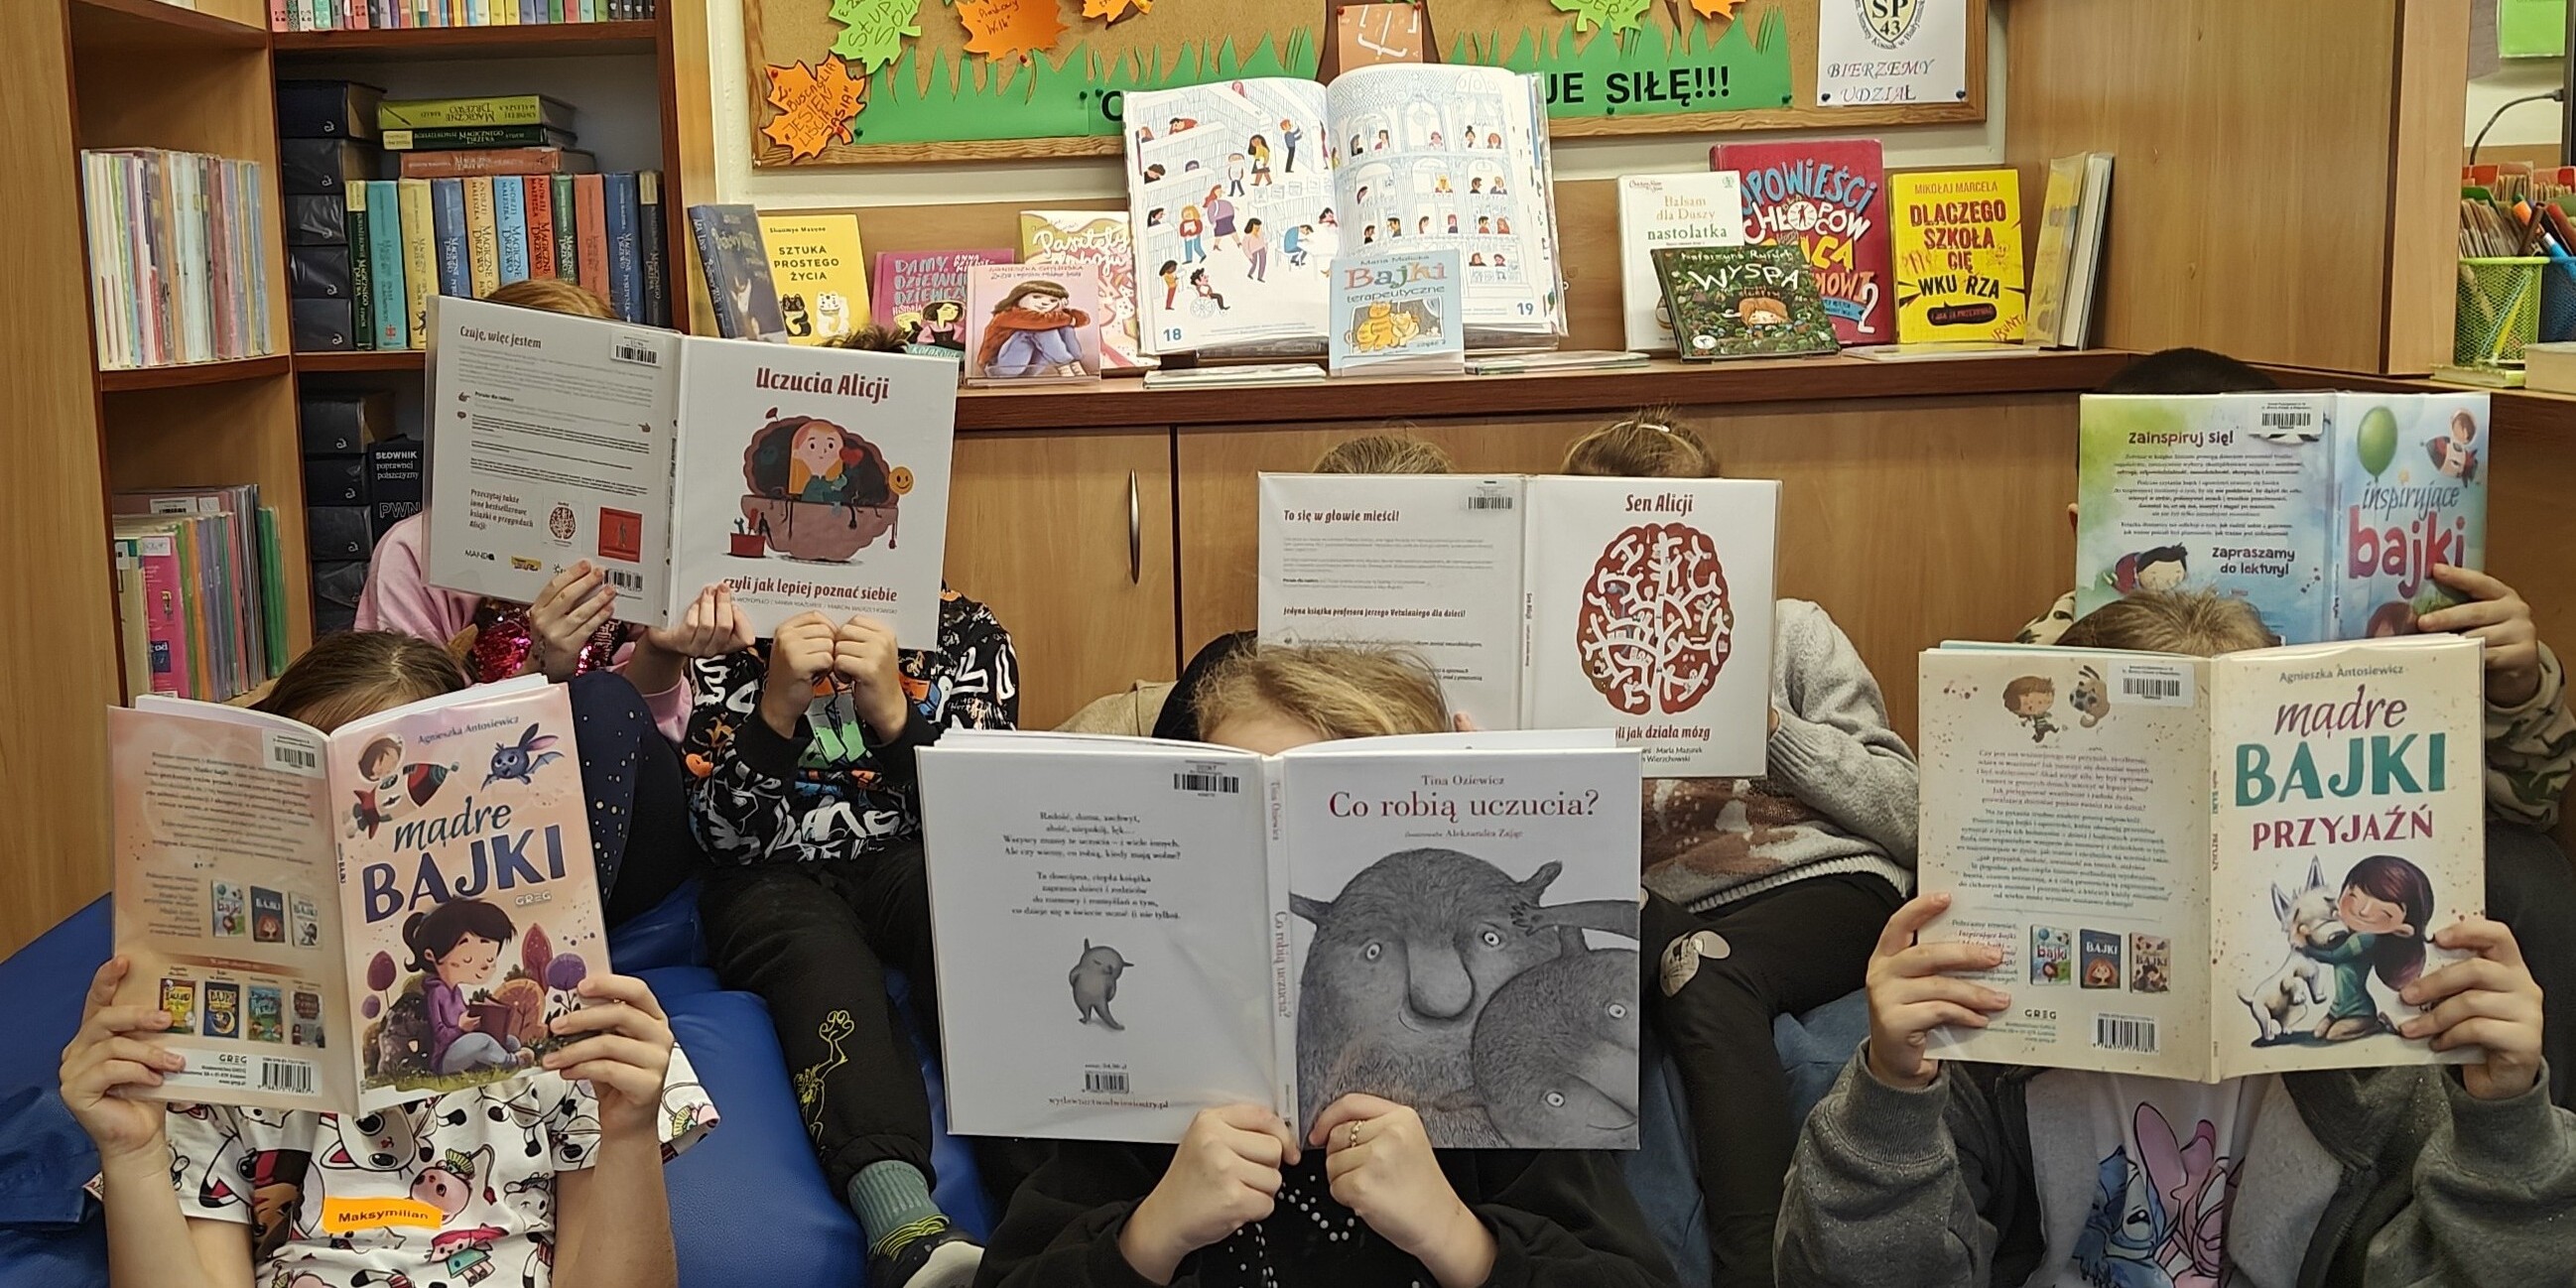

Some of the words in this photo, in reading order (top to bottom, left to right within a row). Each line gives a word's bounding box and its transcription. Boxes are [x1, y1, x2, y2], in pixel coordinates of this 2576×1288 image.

[1871, 0, 1909, 19] SP
[1879, 20, 1901, 36] 43
[1827, 59, 1934, 78] BIERZEMY
[787, 62, 837, 112] BUSCAGLIA
[1606, 65, 1730, 107] SIŁĘ!!!
[1841, 84, 1917, 103] UDZIAŁ
[1914, 183, 1954, 194] MIKOŁAJ
[1955, 181, 1998, 193] MARCELA
[1664, 195, 1707, 207] Balsam
[1656, 208, 1674, 220] dla
[1678, 207, 1716, 220] Duszy
[1909, 199, 2006, 227] DLACZEGO
[1647, 223, 1728, 240] nastolatka
[1923, 226, 1996, 250] SZKOŁA
[502, 228, 514, 274] DRZEWO
[511, 224, 522, 278] MAGICZNE
[530, 225, 543, 271] DRZEWO
[779, 245, 828, 256] SZTUKA
[774, 258, 839, 269] PROSTEGO
[1947, 250, 1974, 273] CIĘ
[790, 270, 828, 282] ŻYCIA
[1344, 262, 1448, 290] Bajki
[1687, 262, 1800, 292] WYSPA
[1347, 286, 1445, 304] terapeutyczne
[1517, 303, 1534, 316] 19
[460, 325, 486, 342] Czuję,
[487, 329, 510, 345] więc
[510, 332, 542, 349] jestem
[1164, 326, 1182, 342] 18
[756, 367, 833, 396] Uczucia
[837, 372, 890, 404] Alicji
[2128, 432, 2204, 449] Zainspiruj
[2208, 430, 2234, 447] się!
[375, 450, 418, 460] SŁOWNIK
[379, 501, 421, 519] PWN
[1625, 494, 1652, 513] Sen
[1654, 493, 1694, 517] Alicji
[2362, 480, 2461, 522] inspirujące
[1283, 509, 1295, 522] To
[1297, 509, 1313, 523] się
[1314, 512, 1323, 522] w
[1325, 509, 1360, 524] głowie
[1363, 509, 1400, 523] mieści!
[2212, 546, 2295, 564] Zapraszamy
[2348, 504, 2466, 599] bajki
[2220, 561, 2238, 575] do
[2240, 560, 2289, 578] lektury!
[752, 577, 775, 593] jak
[777, 578, 813, 597] lepiej
[814, 584, 860, 599] poznać
[860, 585, 898, 602] siebie
[2279, 670, 2333, 684] Agnieszka
[2337, 664, 2404, 678] Antosiewicz
[2273, 684, 2408, 739] mądre
[417, 726, 463, 745] Agnieszka
[464, 715, 519, 733] Antosiewicz
[1625, 725, 1643, 742] jak
[1645, 723, 1679, 739] działa
[1681, 724, 1711, 741] mózg
[2236, 732, 2446, 808] BAJKI
[1422, 775, 1449, 786] Tina
[1453, 774, 1504, 786] Oziewicz
[1329, 791, 1368, 818] Co
[1380, 791, 1458, 823] robią
[1470, 790, 1600, 818] uczucia?
[393, 796, 512, 852] mądre
[2253, 804, 2433, 851] PRZYJAŹŃ
[362, 825, 567, 924] BAJKI
[515, 891, 553, 906] GREG
[2036, 945, 2068, 962] bajki
[2086, 941, 2119, 956] BAJKI
[2024, 1009, 2057, 1020] GREG
[218, 1054, 247, 1065] GREG
[338, 1206, 430, 1225] Maksymilian
